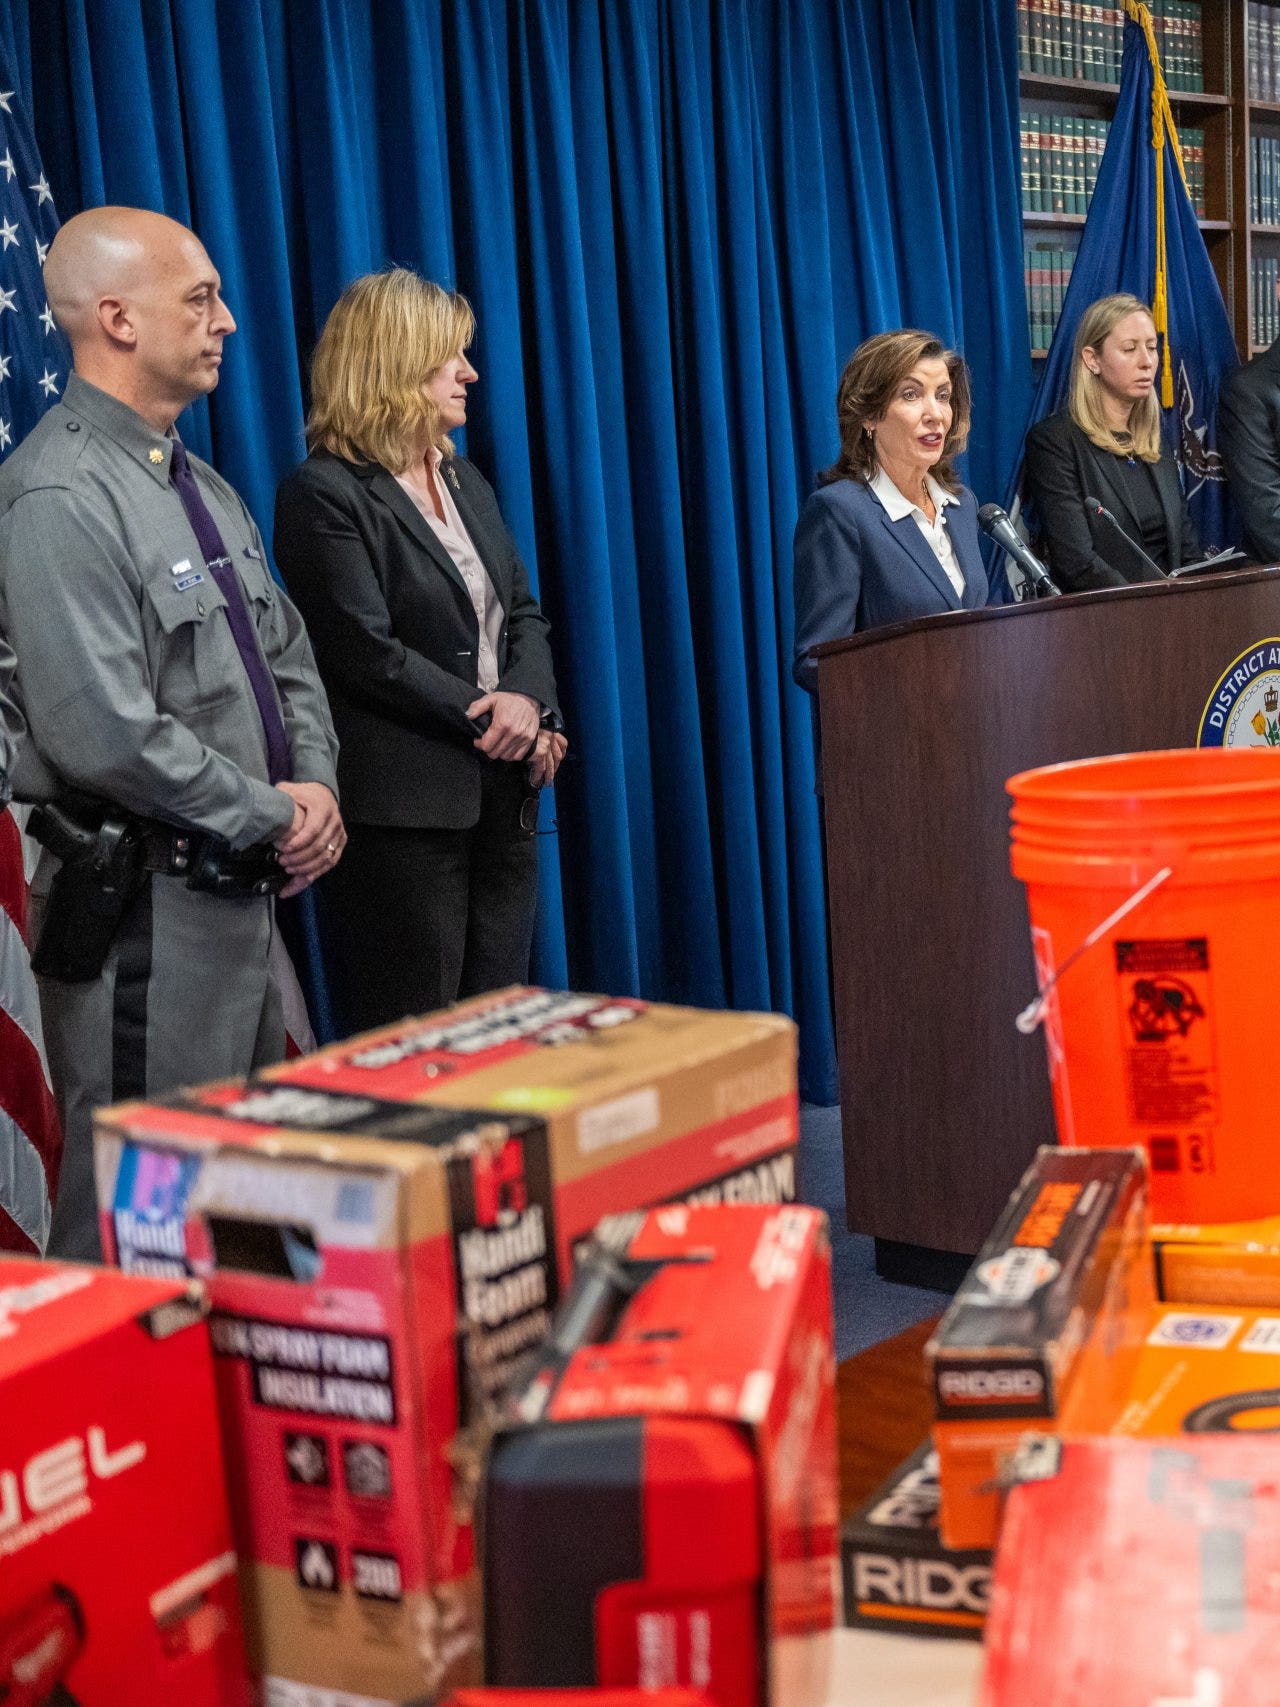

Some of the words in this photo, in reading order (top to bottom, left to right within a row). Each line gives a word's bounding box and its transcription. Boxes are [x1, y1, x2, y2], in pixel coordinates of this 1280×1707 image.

[1209, 650, 1265, 728] DISTRICT
[938, 1368, 1045, 1398] RIDGID
[852, 1552, 994, 1609] RIDG
